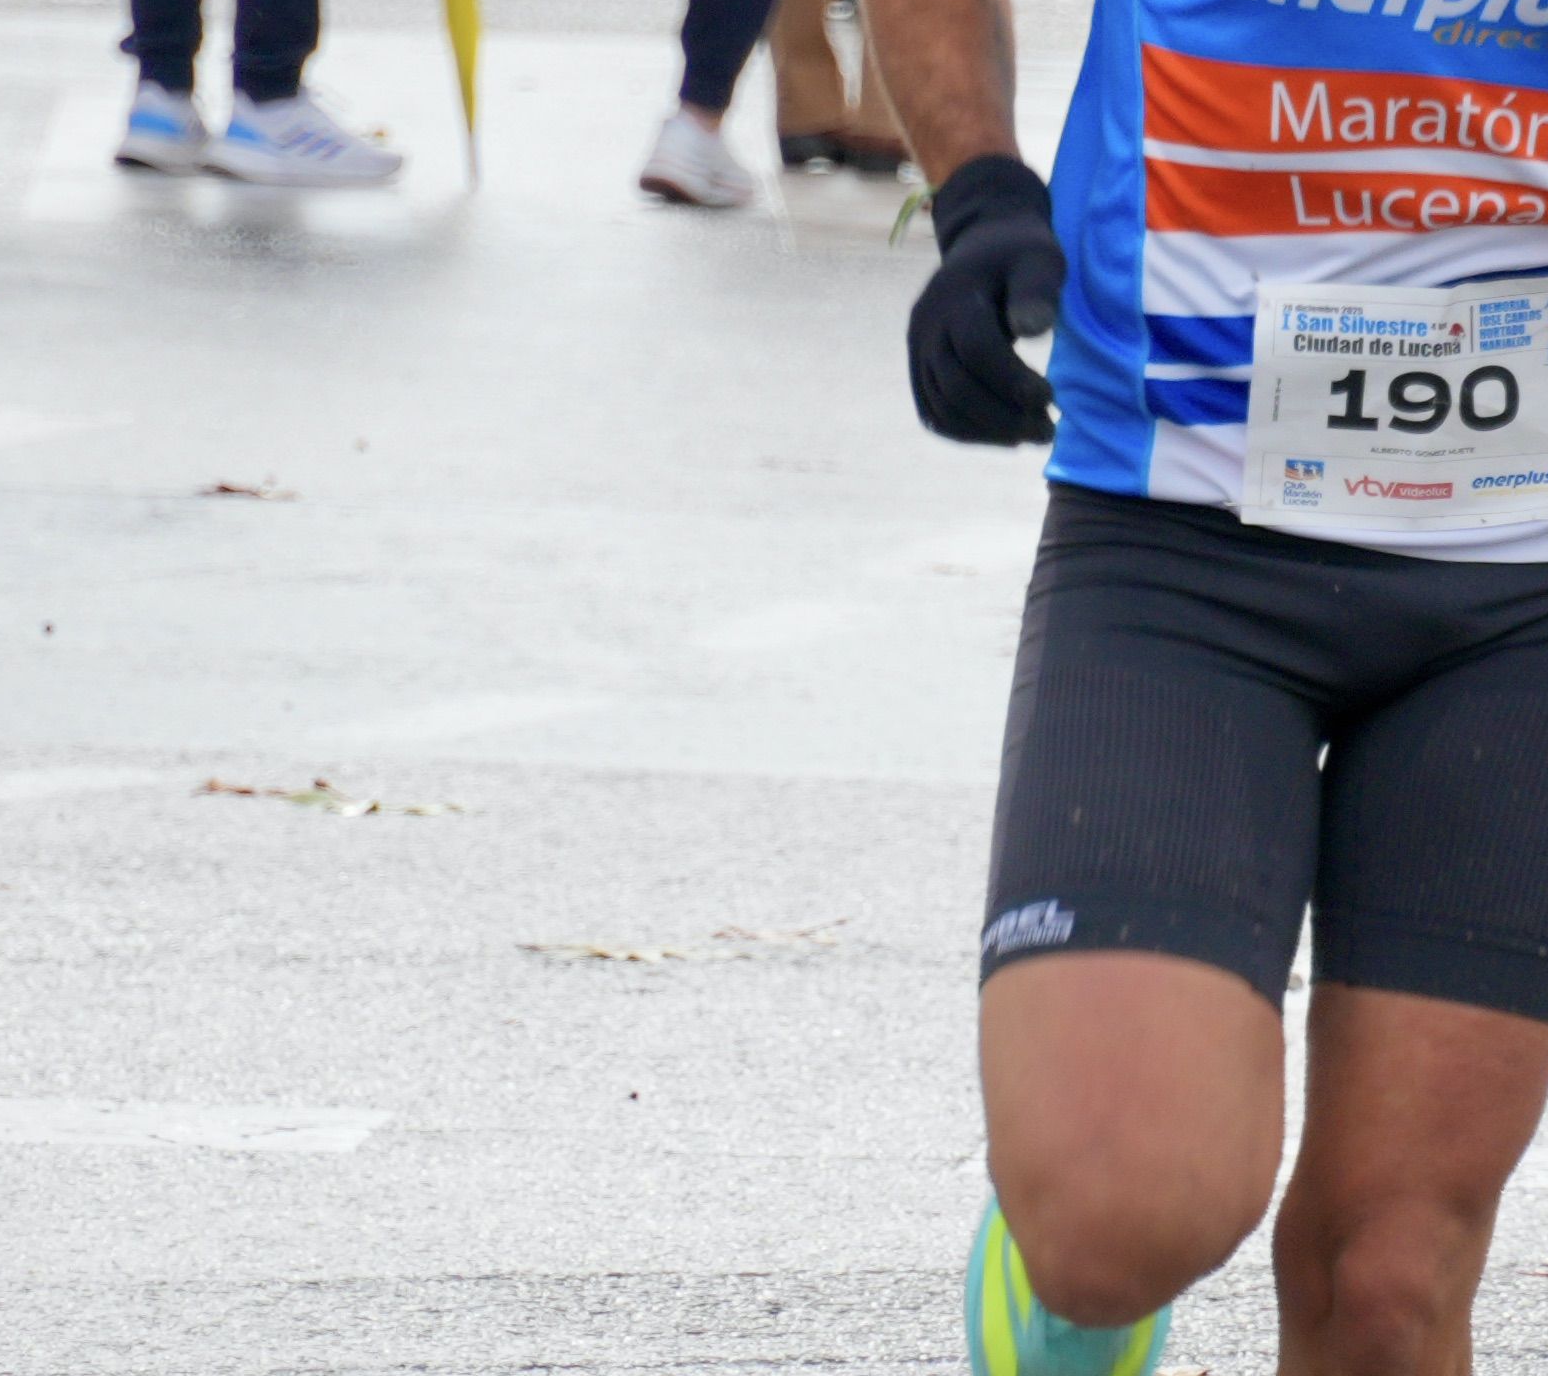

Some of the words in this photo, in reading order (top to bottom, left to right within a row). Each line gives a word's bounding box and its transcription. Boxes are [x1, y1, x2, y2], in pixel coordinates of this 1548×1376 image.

[1289, 174, 1547, 230] Lucena
[1296, 312, 1334, 333] San
[1338, 314, 1428, 337] Silvestre
[1293, 333, 1364, 355] Ciudad
[1369, 337, 1394, 356] de
[1398, 338, 1462, 357] Lucena
[1326, 364, 1520, 435] 190
[1283, 480, 1308, 491] Club
[1283, 488, 1323, 500] Maratón
[1343, 475, 1397, 498] vtv
[1283, 496, 1319, 507] Lucena
